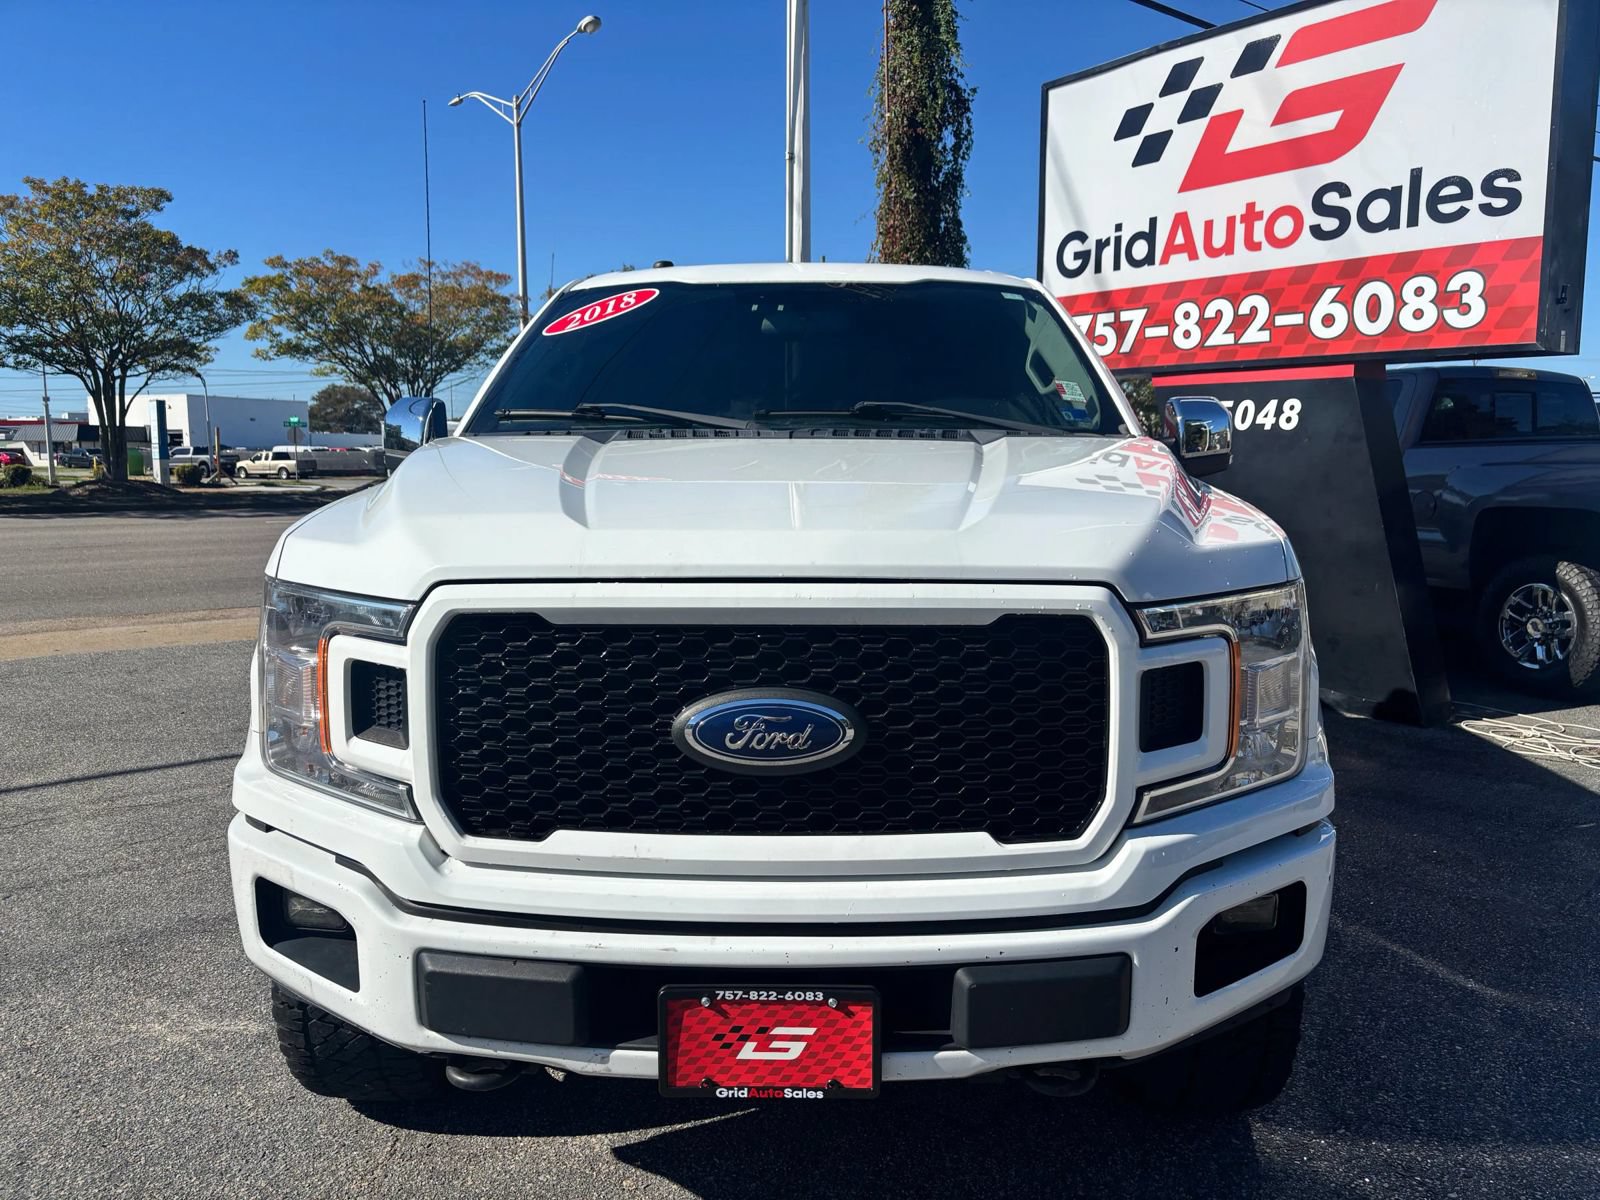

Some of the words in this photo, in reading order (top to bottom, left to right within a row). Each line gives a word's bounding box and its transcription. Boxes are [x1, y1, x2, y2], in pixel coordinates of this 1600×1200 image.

[564, 292, 637, 330] 2018
[725, 714, 815, 750] Ford
[715, 990, 824, 1002] 757-822-6083
[715, 1087, 824, 1099] GridAutoSales
